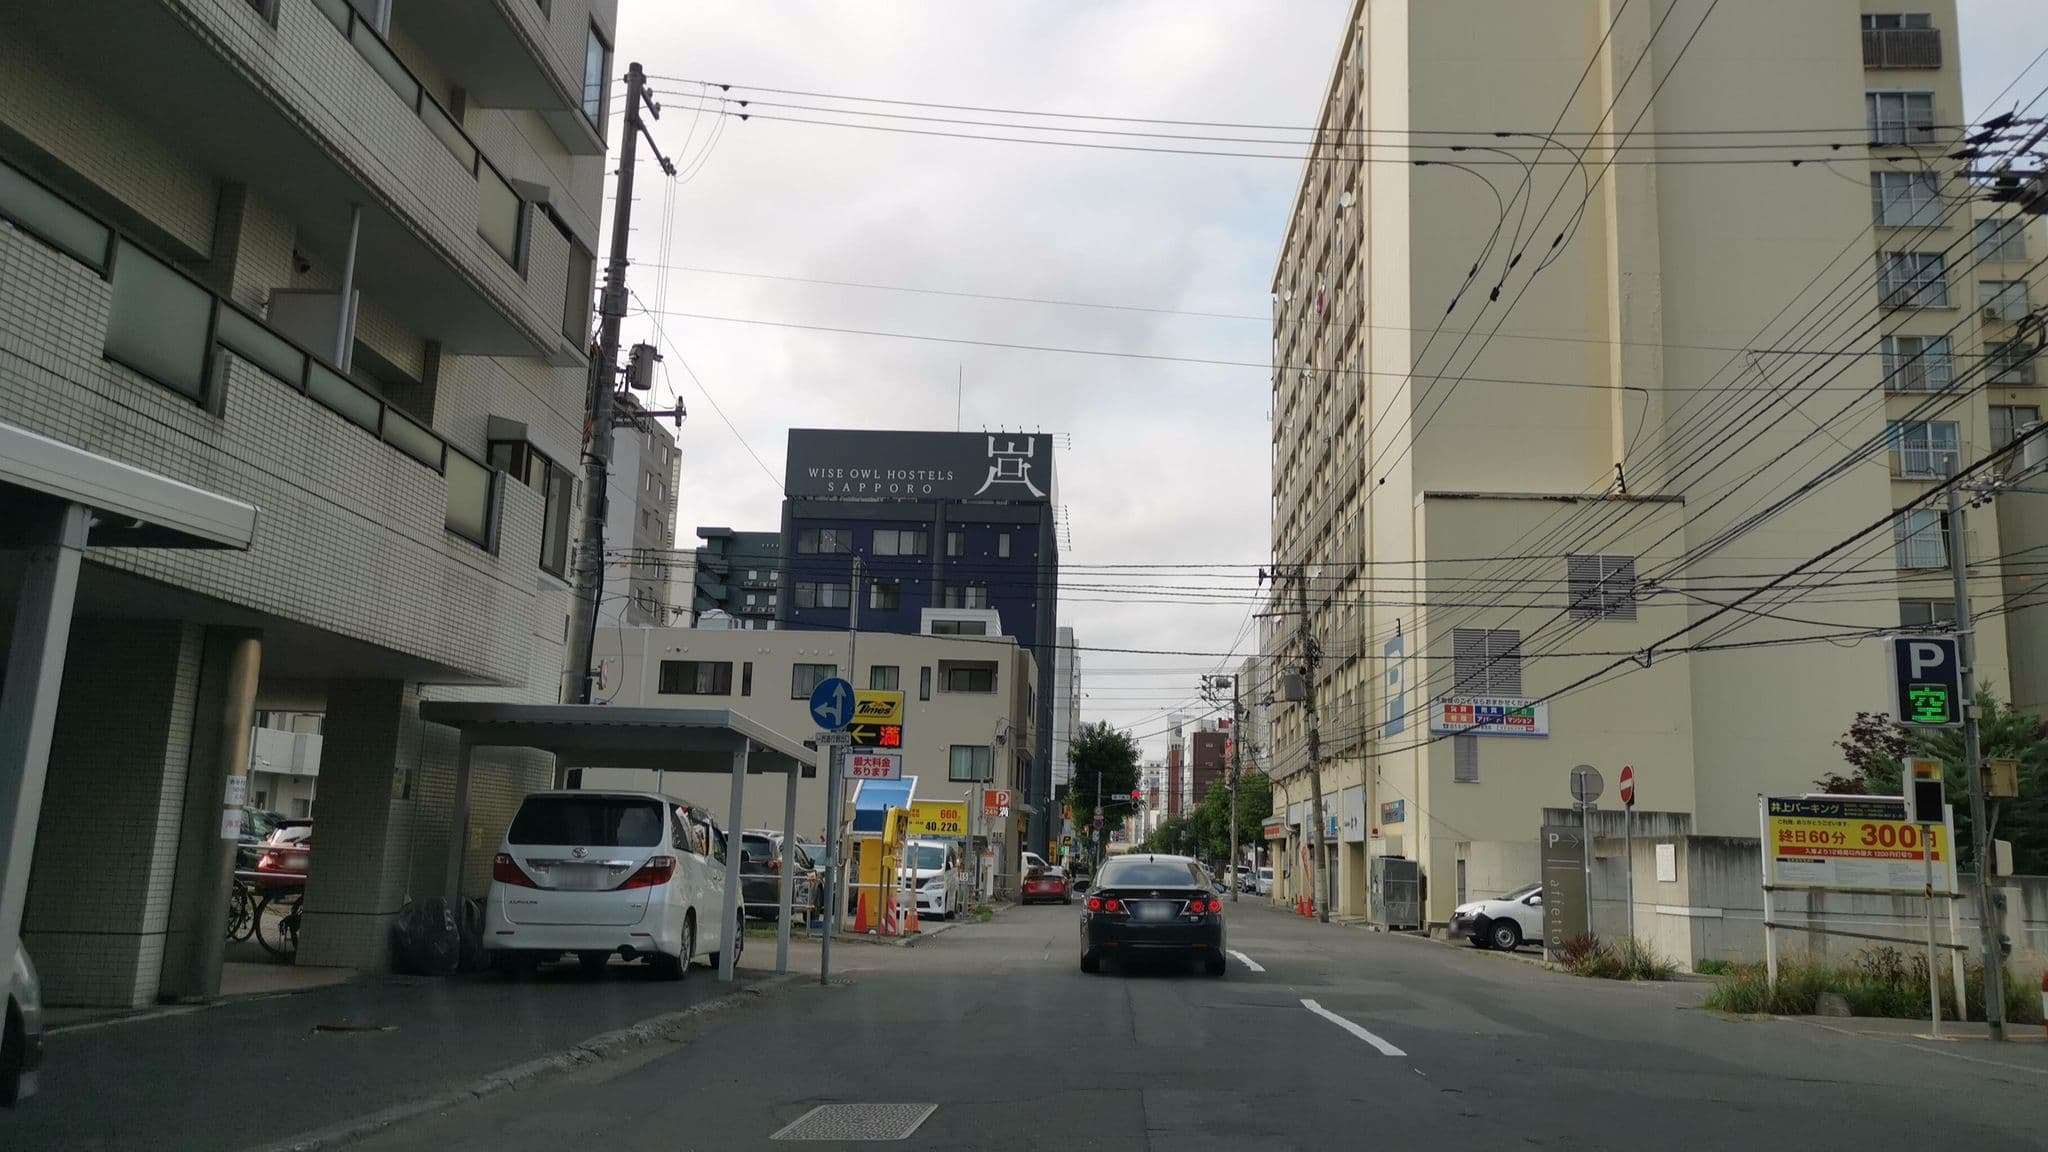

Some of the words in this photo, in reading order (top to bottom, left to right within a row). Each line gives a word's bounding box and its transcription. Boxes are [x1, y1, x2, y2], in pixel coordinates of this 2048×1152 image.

[808, 468, 843, 479] WISE
[850, 469, 881, 479] OWL
[887, 470, 954, 481] HOSTELS
[827, 482, 933, 494] SAPPORO
[1909, 642, 1945, 679] P
[857, 701, 897, 715] Times
[1909, 687, 1947, 721] 空
[880, 726, 900, 745] 満
[853, 757, 891, 767] 最大料金
[853, 767, 890, 776] あります
[1549, 833, 1560, 848] P
